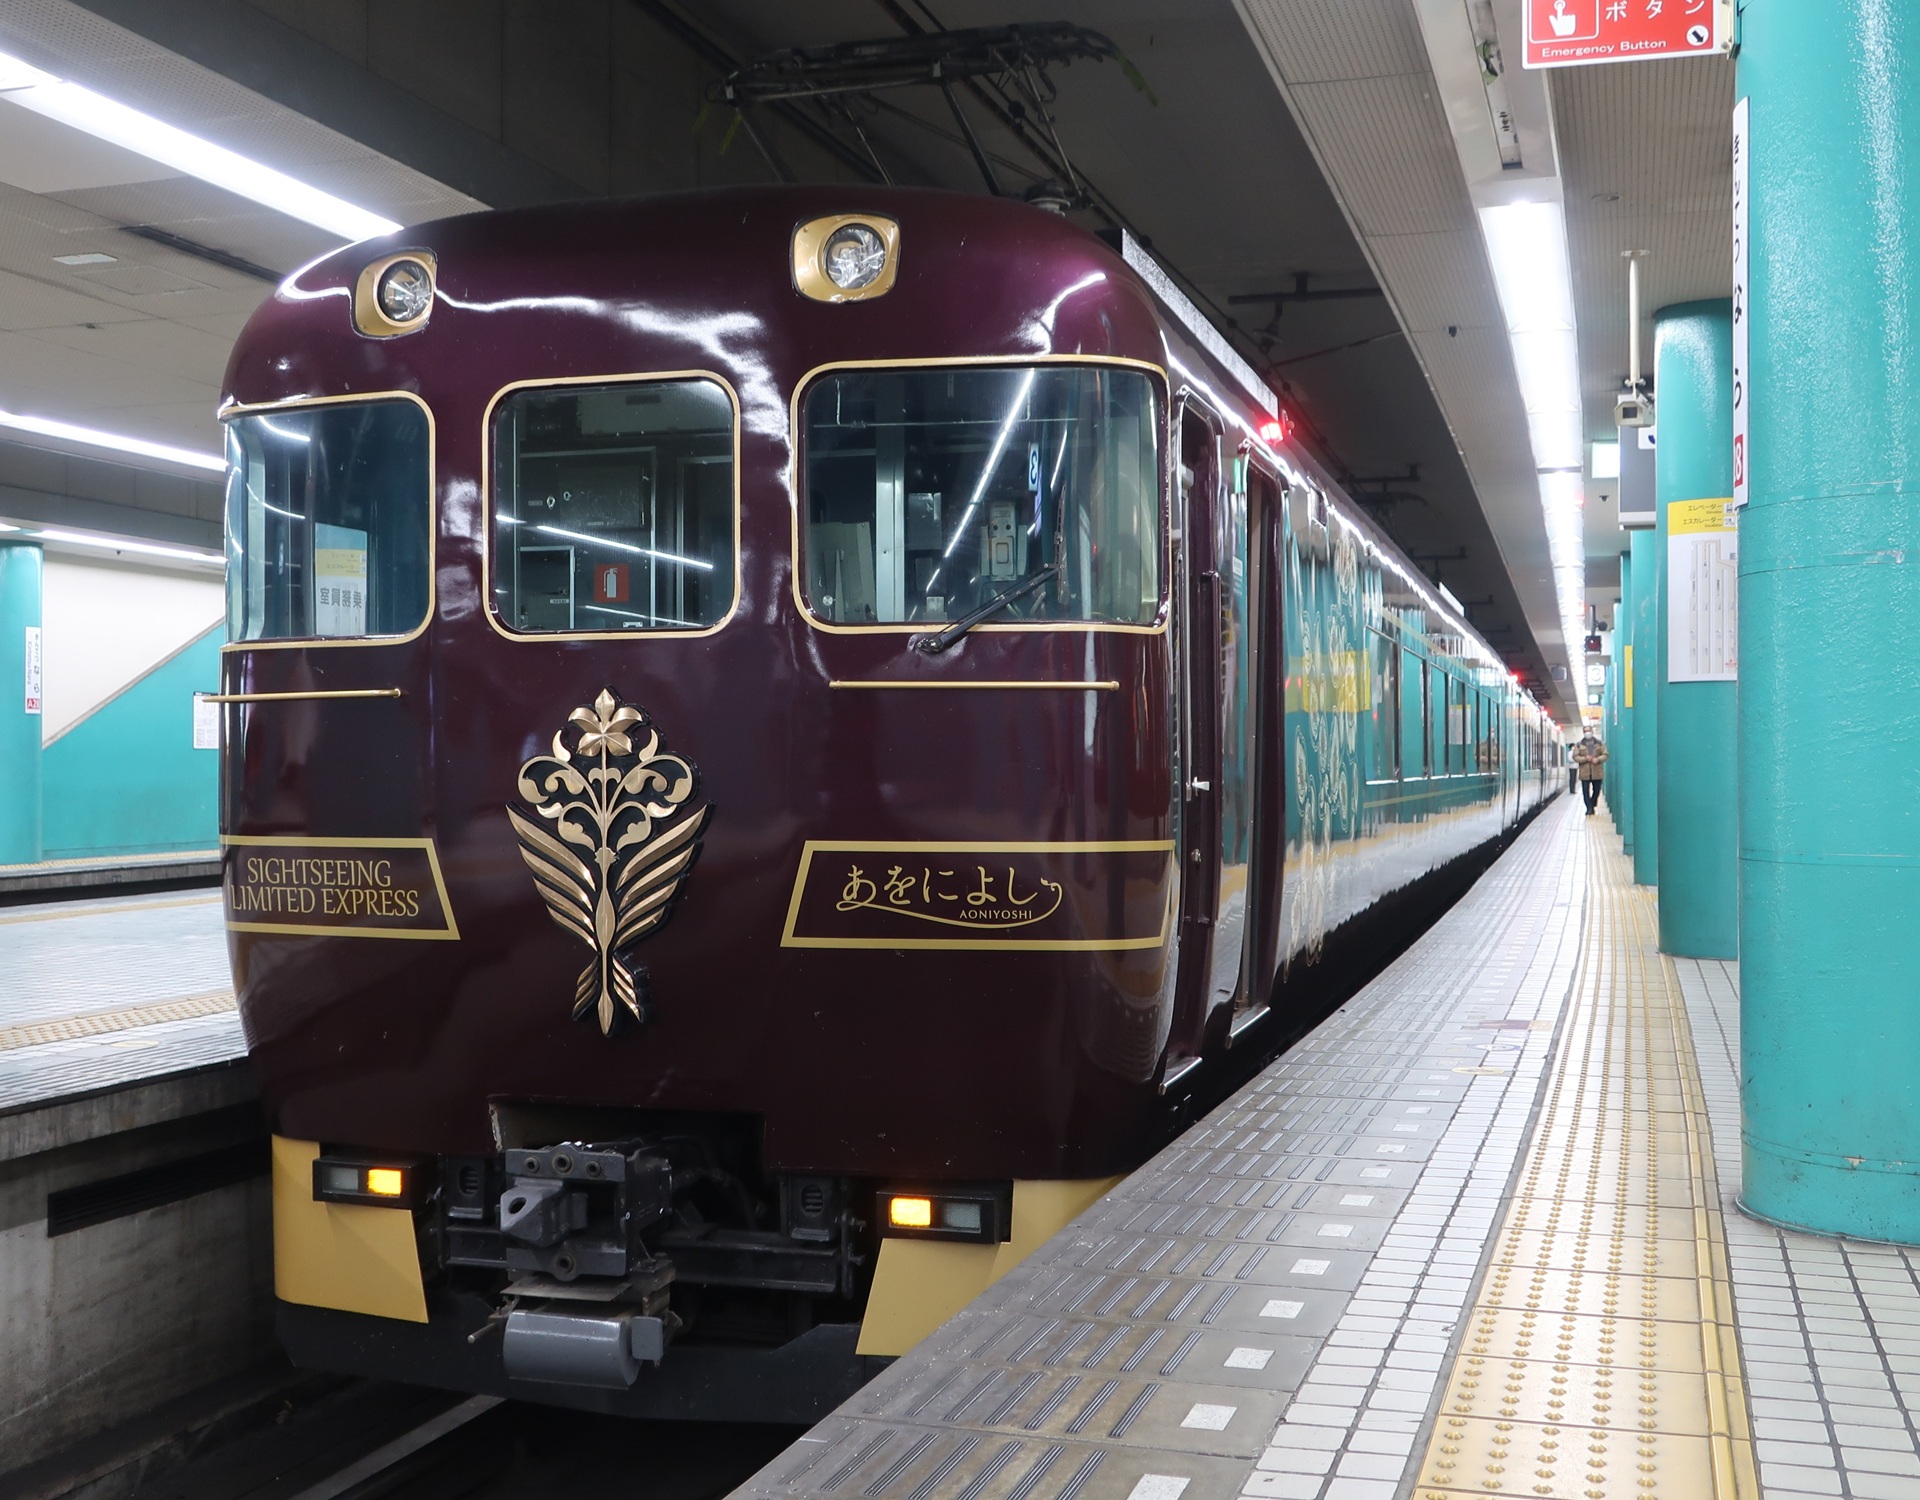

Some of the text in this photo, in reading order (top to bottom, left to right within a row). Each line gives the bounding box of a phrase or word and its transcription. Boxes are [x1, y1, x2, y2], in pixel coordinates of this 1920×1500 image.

[1605, 0, 1705, 22] ボタン
[1542, 40, 1667, 58] Emergency Button
[247, 857, 391, 887] SIGHTSEEING
[231, 885, 419, 917] LIMITED EXPRESS
[836, 865, 1039, 911] あをによし
[959, 910, 1033, 920] AONIYOSHI
